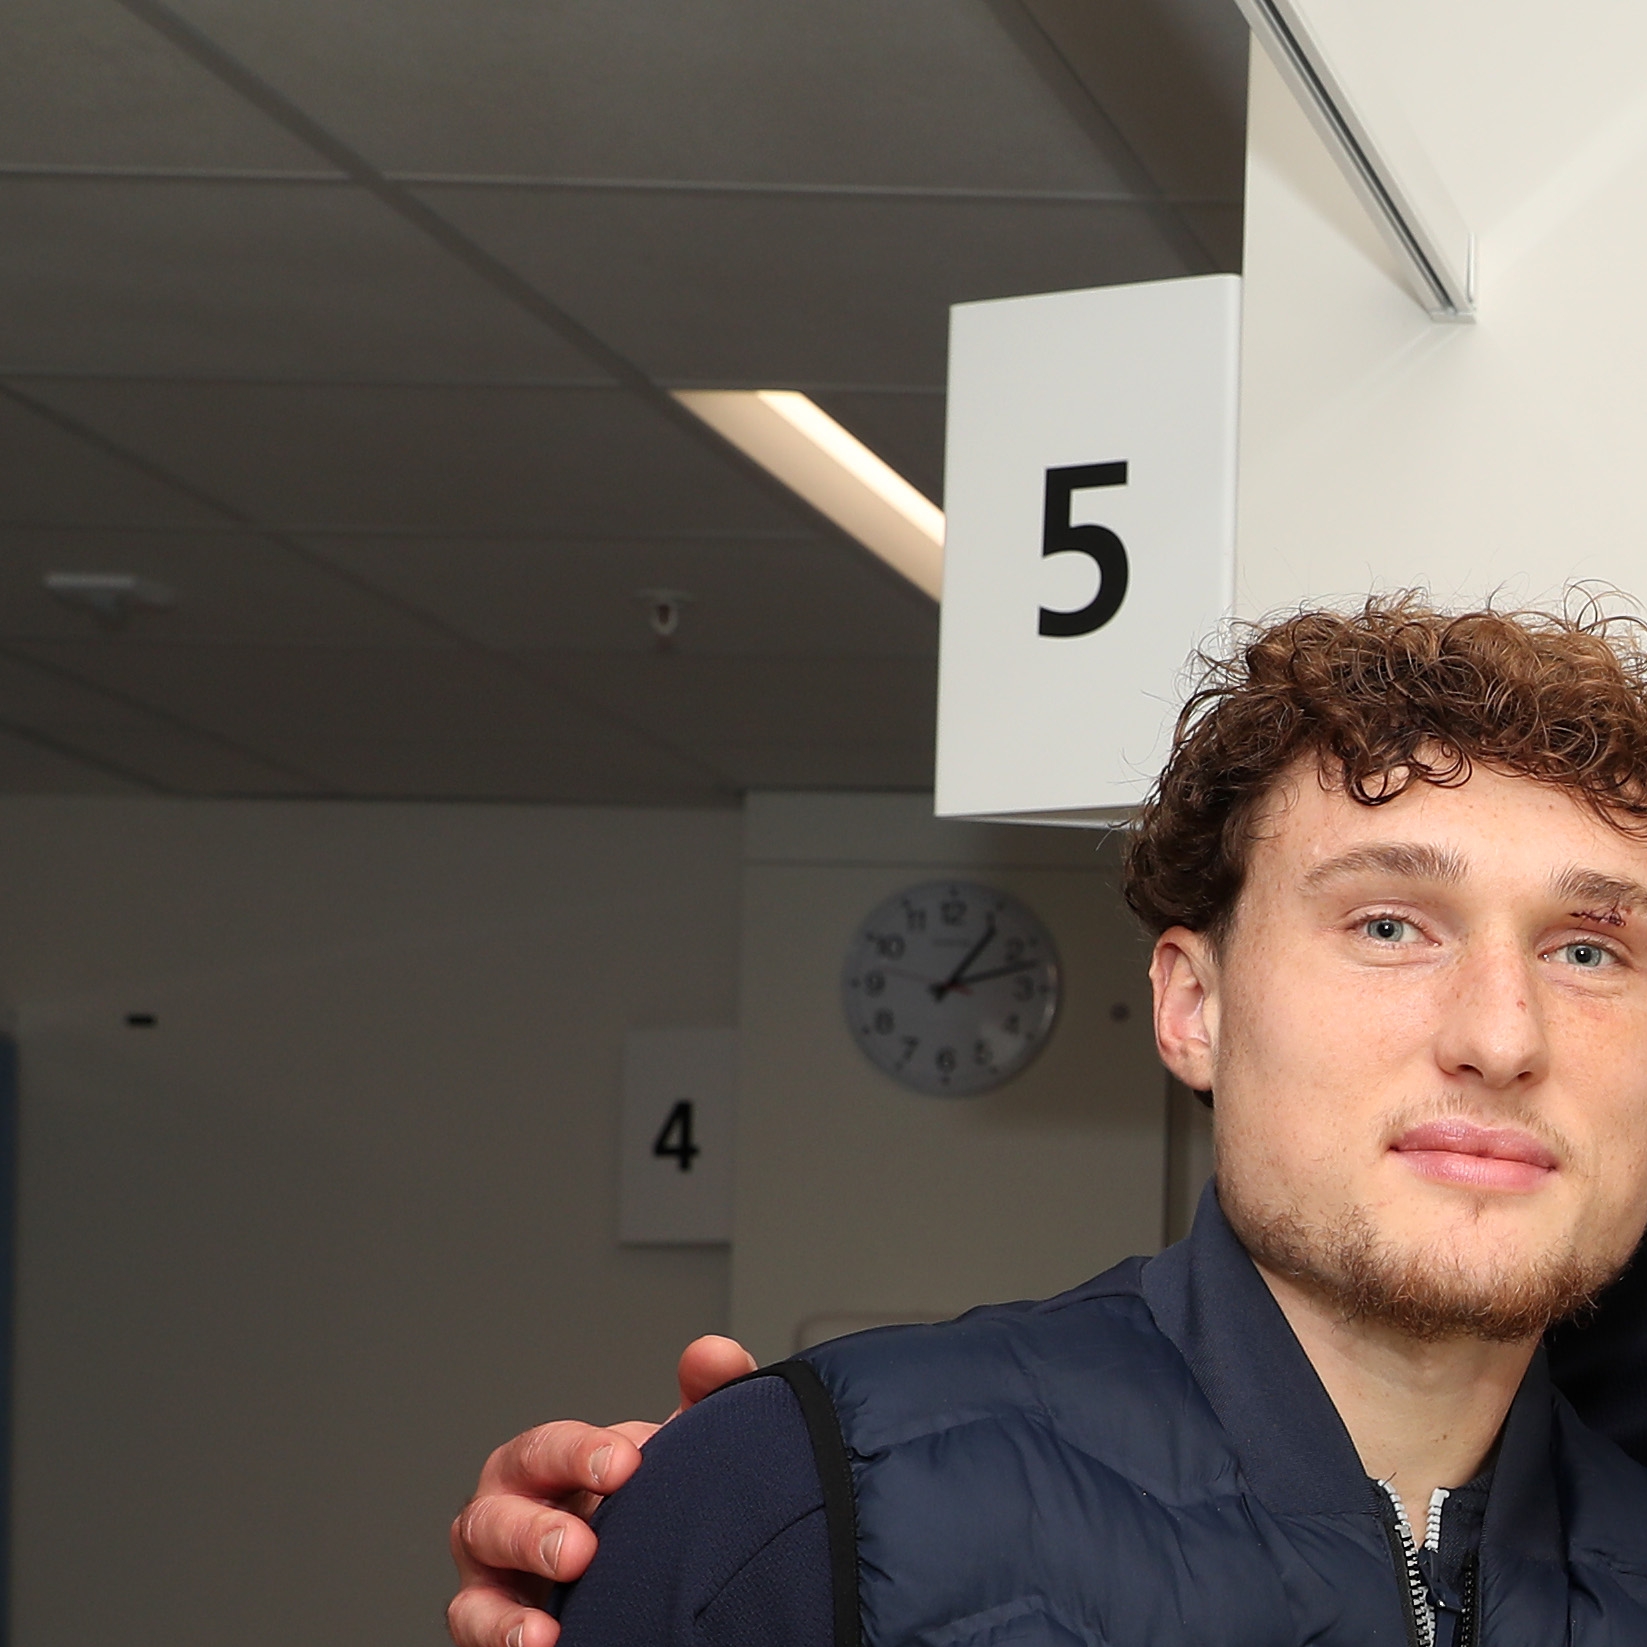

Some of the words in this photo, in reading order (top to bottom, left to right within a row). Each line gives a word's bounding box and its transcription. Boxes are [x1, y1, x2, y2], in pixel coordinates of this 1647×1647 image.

[1038, 460, 1129, 638] 5
[907, 908, 927, 931] 11
[940, 900, 967, 926] 12
[876, 933, 906, 961] 10
[1006, 935, 1024, 961] 2
[865, 970, 886, 997] 9
[1014, 974, 1035, 1002] 3
[874, 1007, 895, 1035] 8
[902, 1035, 919, 1060] 7
[935, 1046, 956, 1073] 6
[653, 1098, 700, 1172] 4
